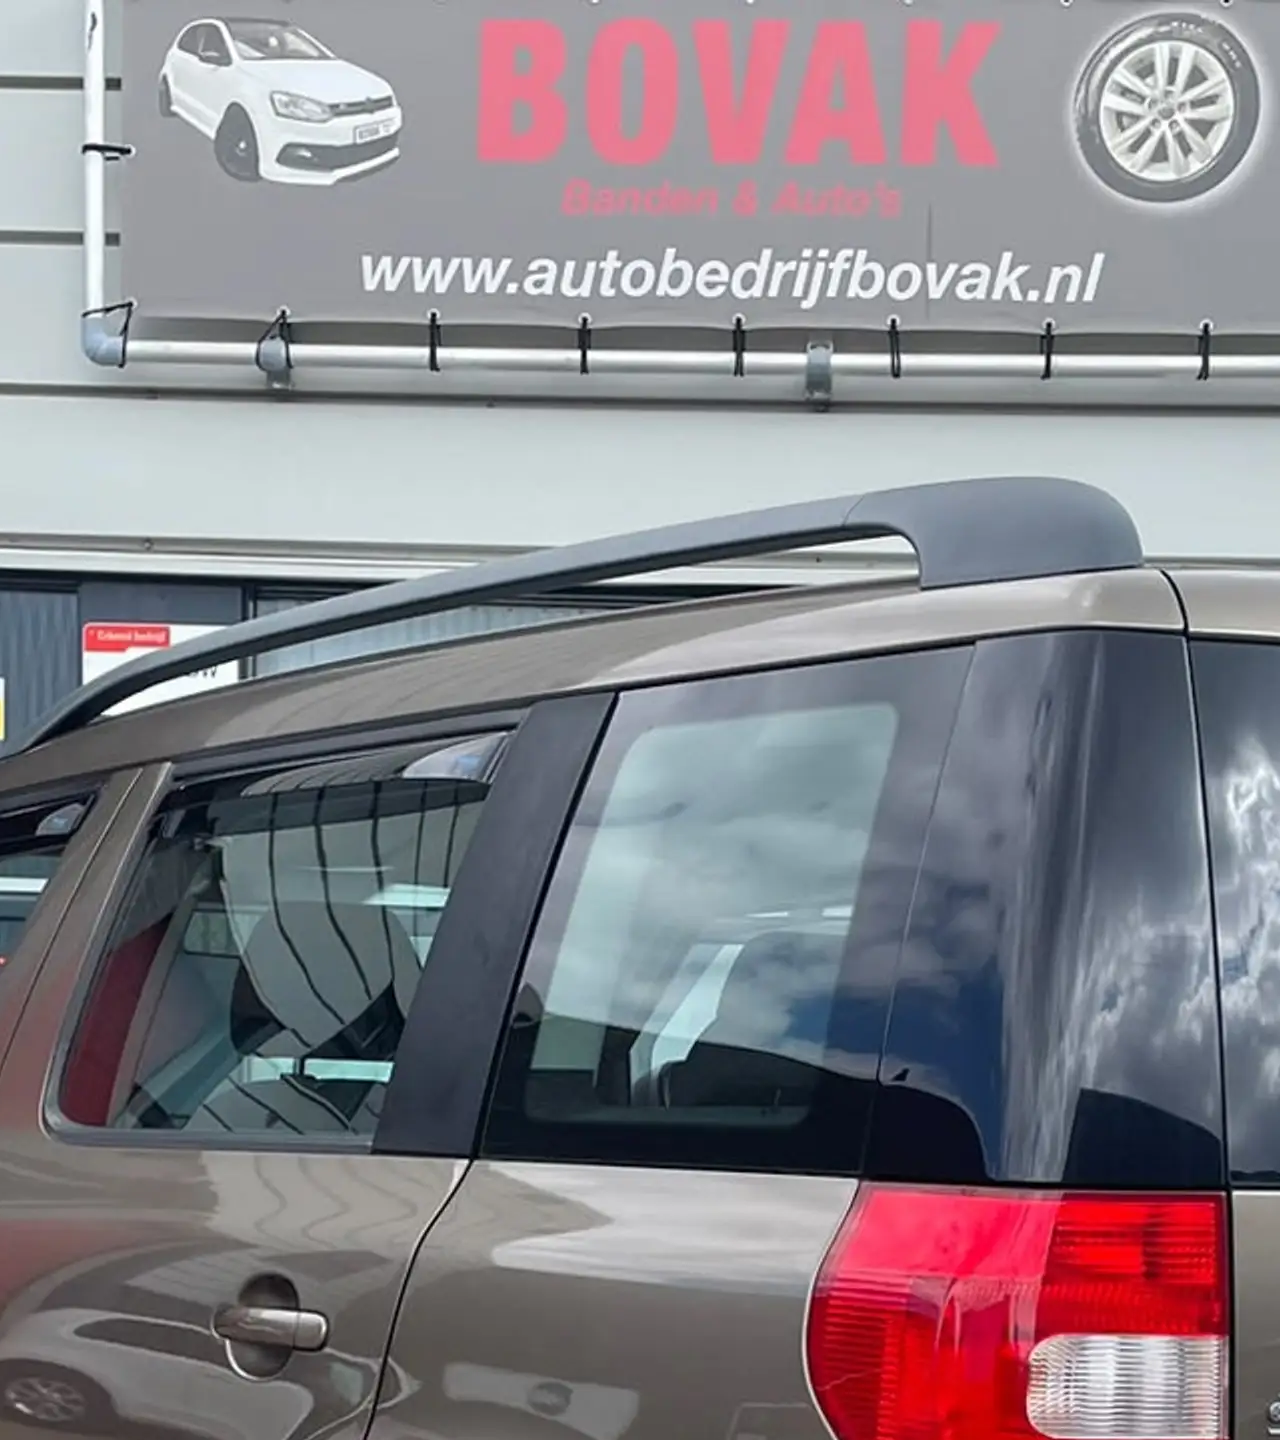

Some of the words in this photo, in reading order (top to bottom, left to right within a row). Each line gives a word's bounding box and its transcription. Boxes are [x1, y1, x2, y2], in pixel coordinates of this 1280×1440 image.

[477, 17, 1002, 167] BOVAK
[561, 178, 719, 217] Banden
[733, 179, 759, 218] &
[772, 181, 902, 219] Auto's
[361, 247, 1105, 309] www.autobedrijfbovak.nl
